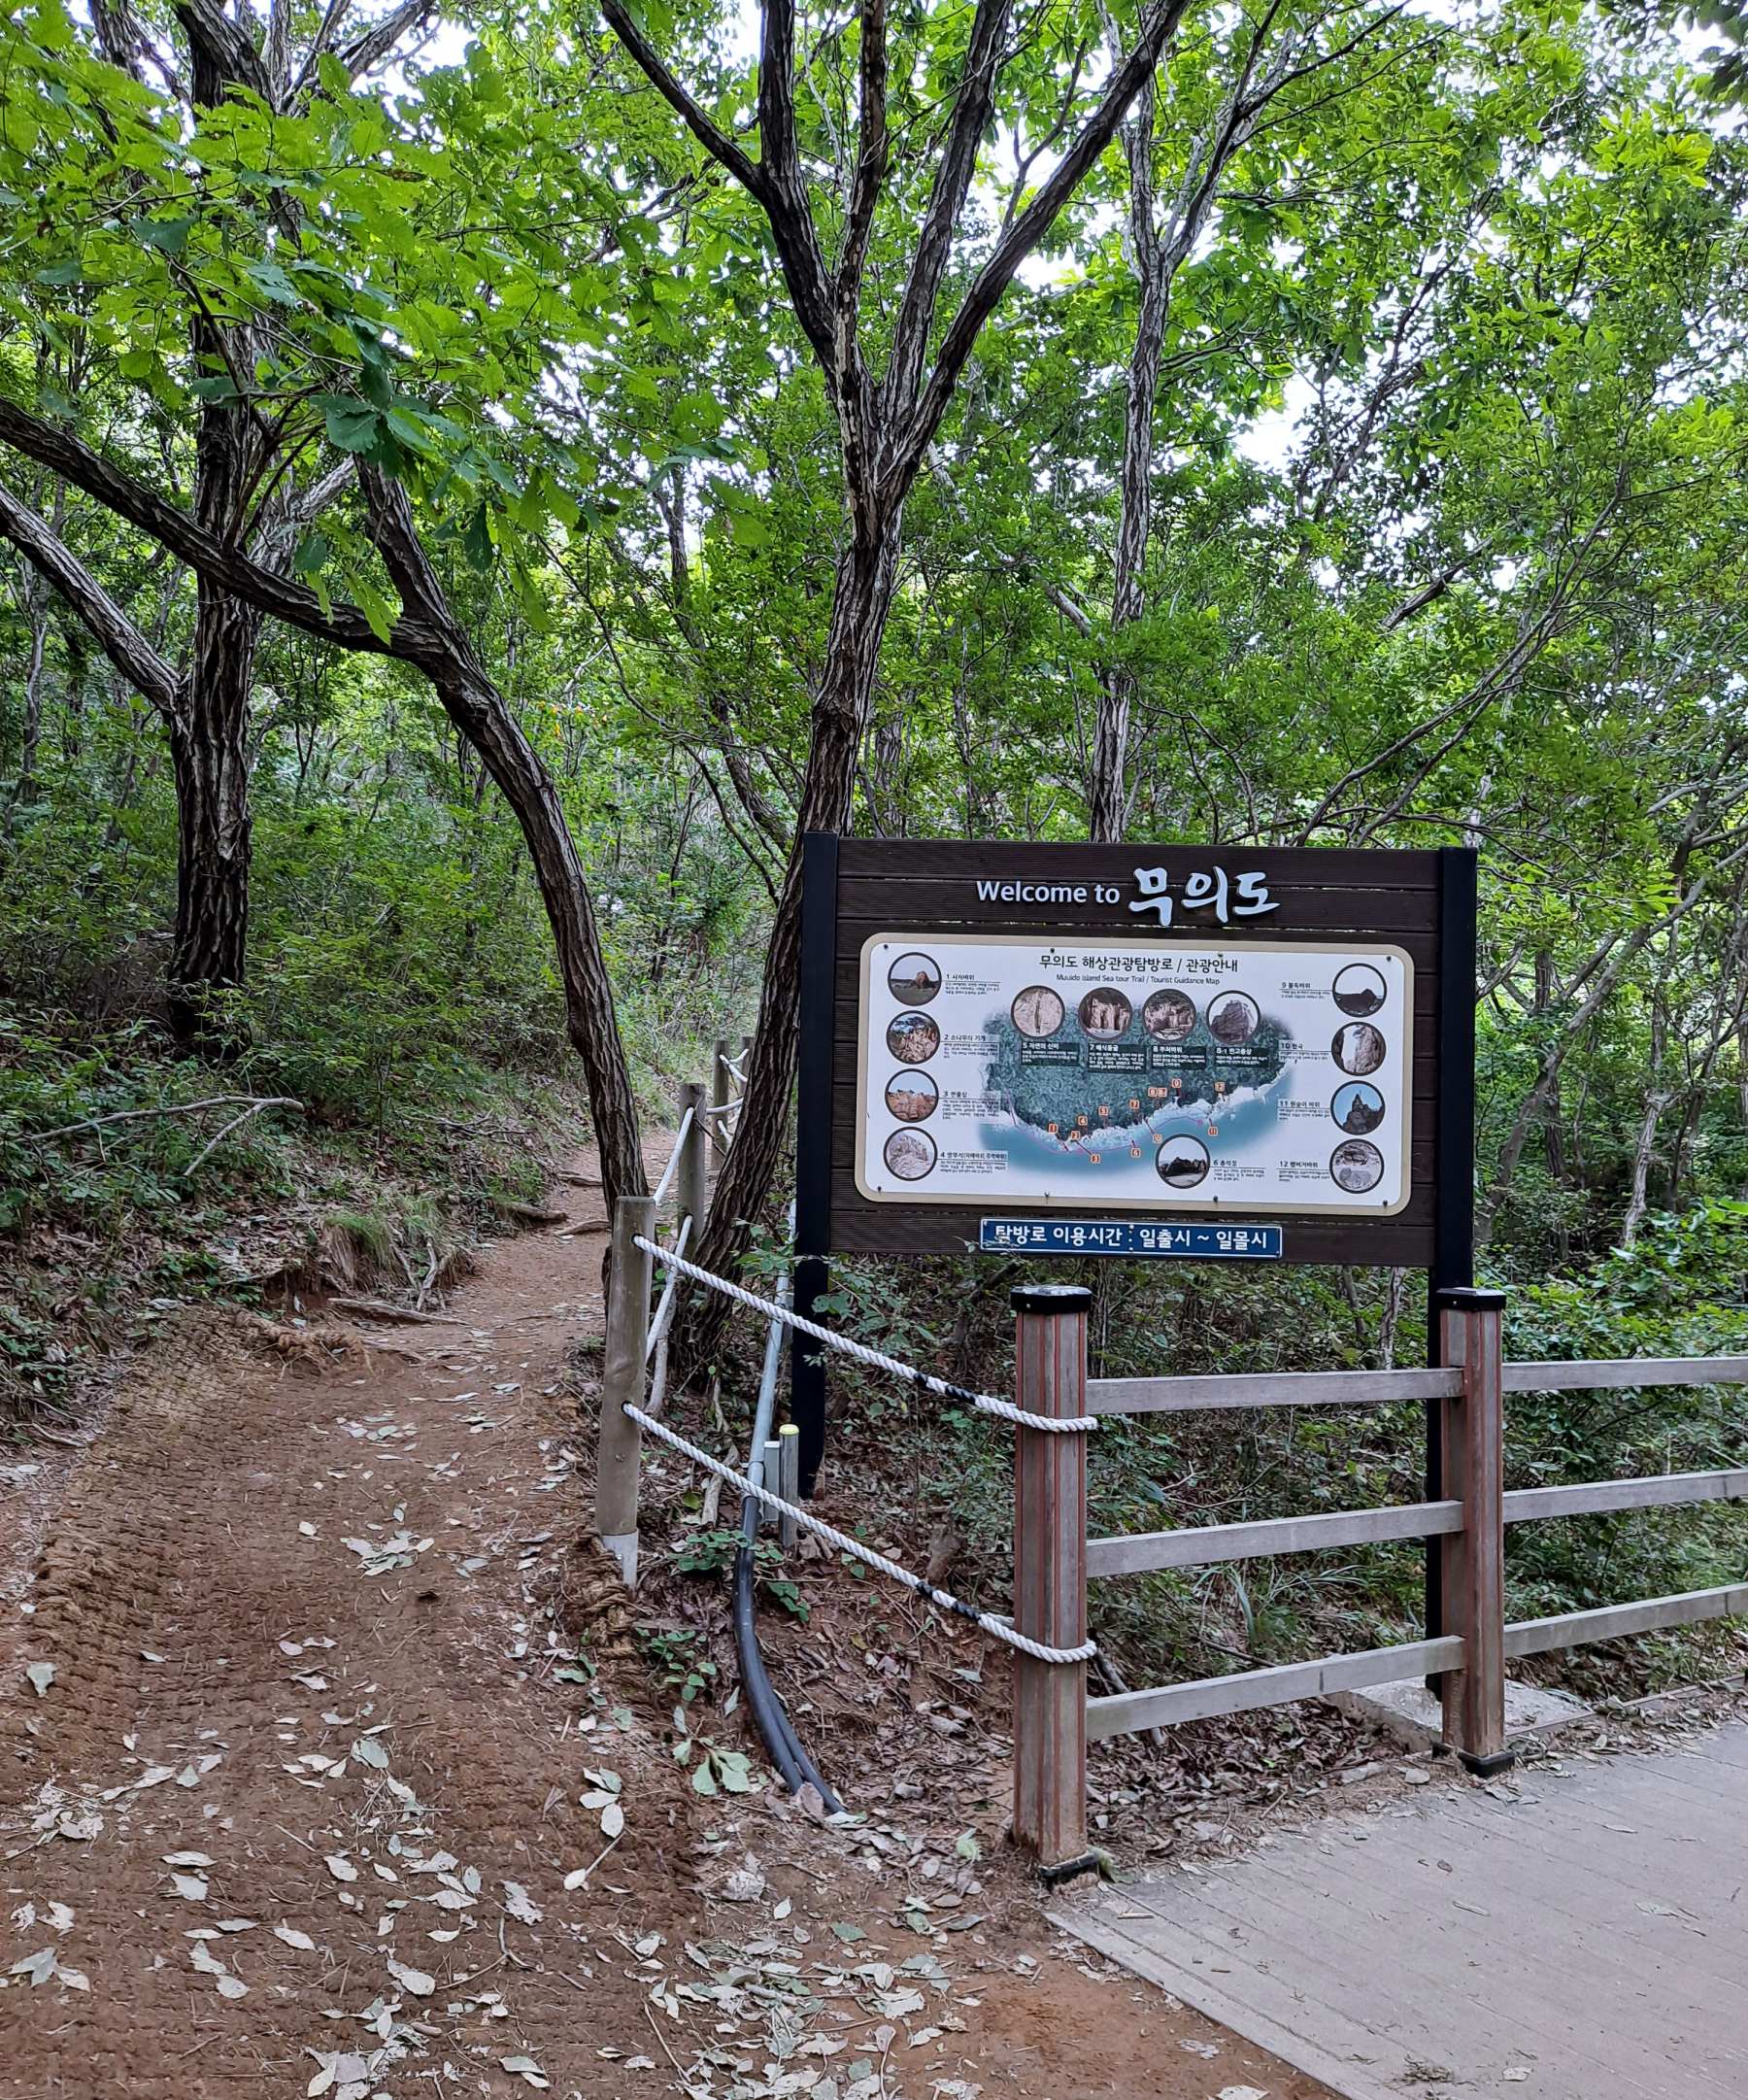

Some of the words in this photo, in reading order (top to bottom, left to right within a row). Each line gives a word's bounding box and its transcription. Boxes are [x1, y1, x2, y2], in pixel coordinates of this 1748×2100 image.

[975, 880, 1088, 904] Welcome
[1093, 884, 1120, 904] to
[1127, 865, 1282, 927] 무의도
[1039, 955, 1078, 969] 무의도
[1082, 956, 1174, 972] 해상관광탐방로
[1176, 958, 1182, 973] /
[1186, 959, 1238, 973] 관광안내
[1151, 975, 1172, 984] Tourist
[1173, 976, 1204, 985] Guidance
[994, 1225, 1047, 1244] 탐방로
[1053, 1227, 1123, 1246] 이용시간
[1139, 1229, 1191, 1248] 일출시
[1216, 1231, 1267, 1250] 일몰시
